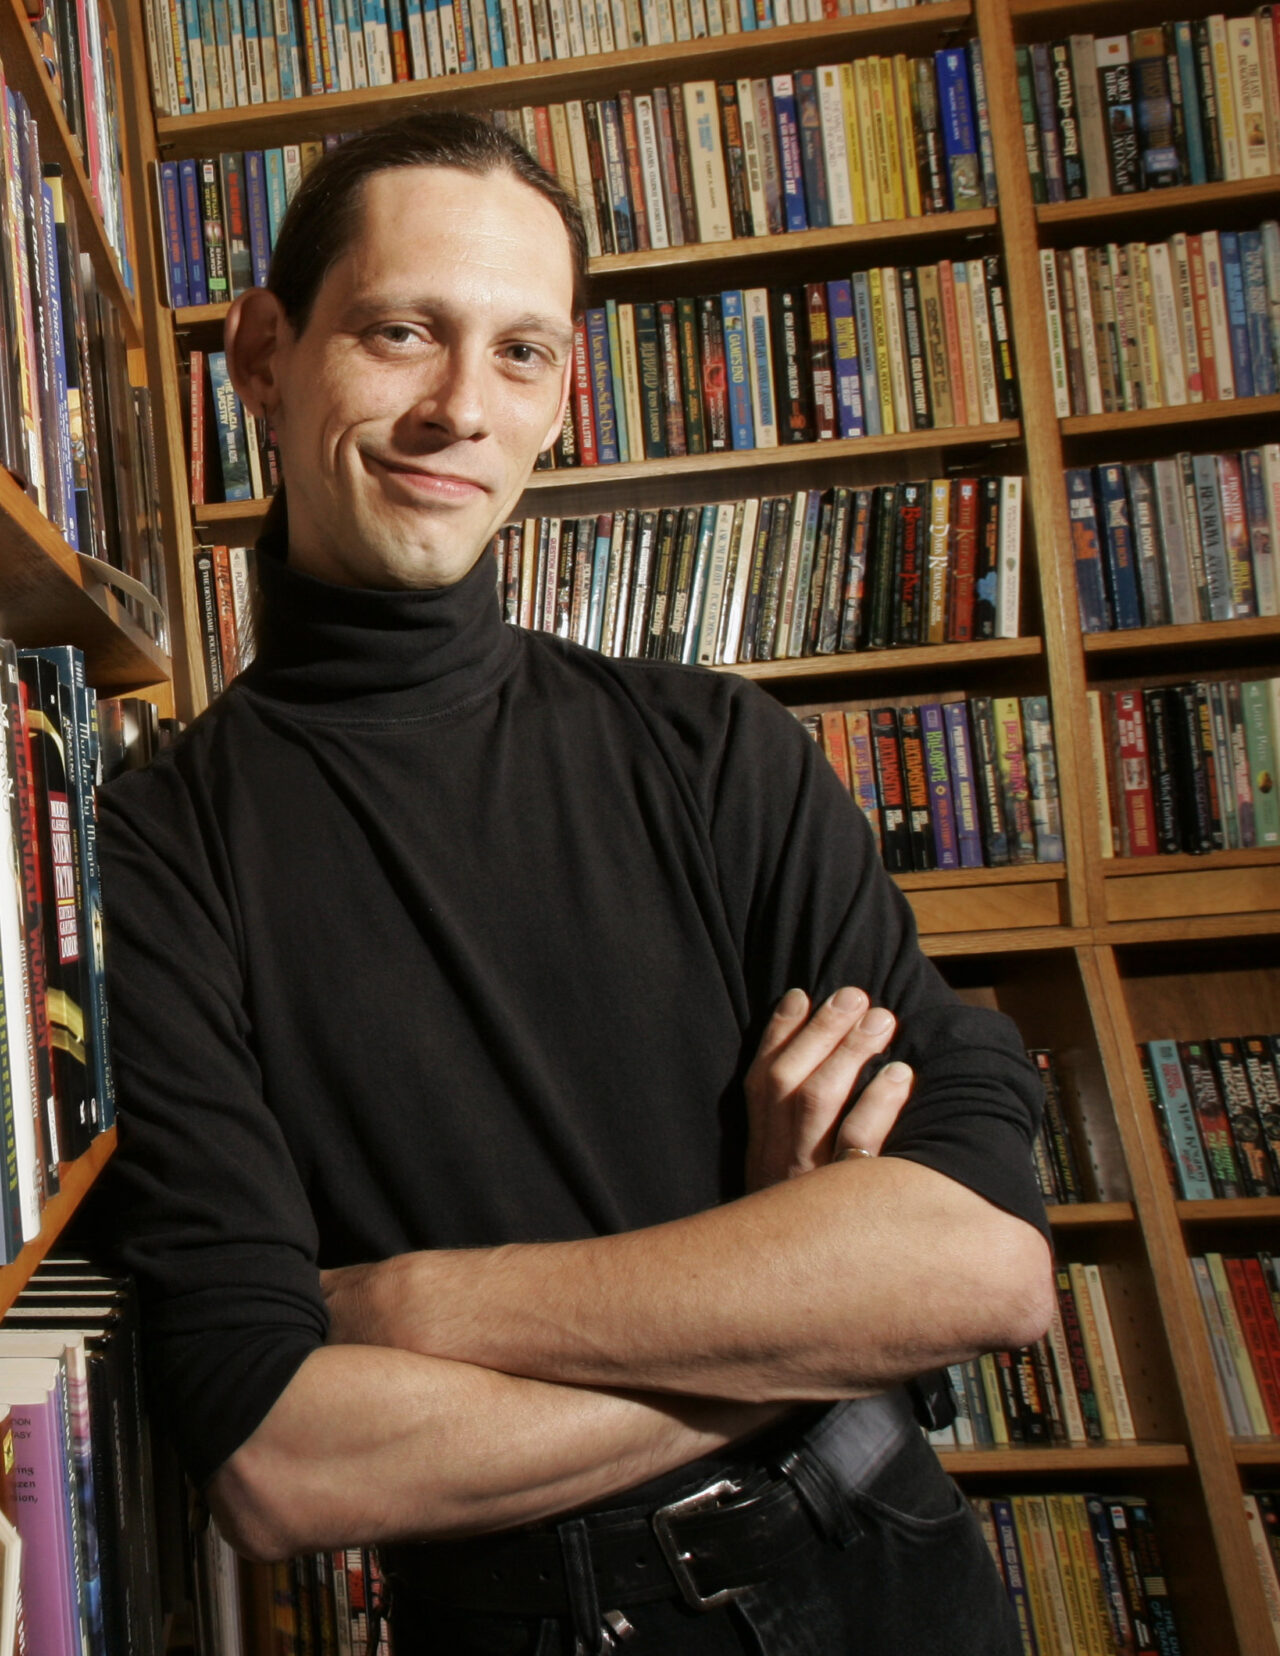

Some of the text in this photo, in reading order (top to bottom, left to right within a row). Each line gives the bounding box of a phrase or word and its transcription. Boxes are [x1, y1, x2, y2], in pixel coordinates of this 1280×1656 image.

[575, 332, 586, 364] GALATEA
[905, 288, 926, 414] POUL ANDERSON COLD VICTORY
[580, 394, 590, 417] AARON
[1137, 502, 1155, 558] BEN BOVA
[1199, 485, 1220, 547] BEN BOVA
[548, 538, 557, 569] QUESTION
[928, 506, 950, 600] THE DARK REMAINS
[878, 736, 904, 806] JUXTAPOSITION
[904, 737, 928, 807] JUXTAPOSITION
[955, 747, 968, 778] ANTHONY
[1218, 1060, 1242, 1116] BROOKS
[1232, 1064, 1253, 1108] TERRY
[1247, 1057, 1272, 1113] BROOKS
[1261, 1063, 1280, 1105] TERRY
